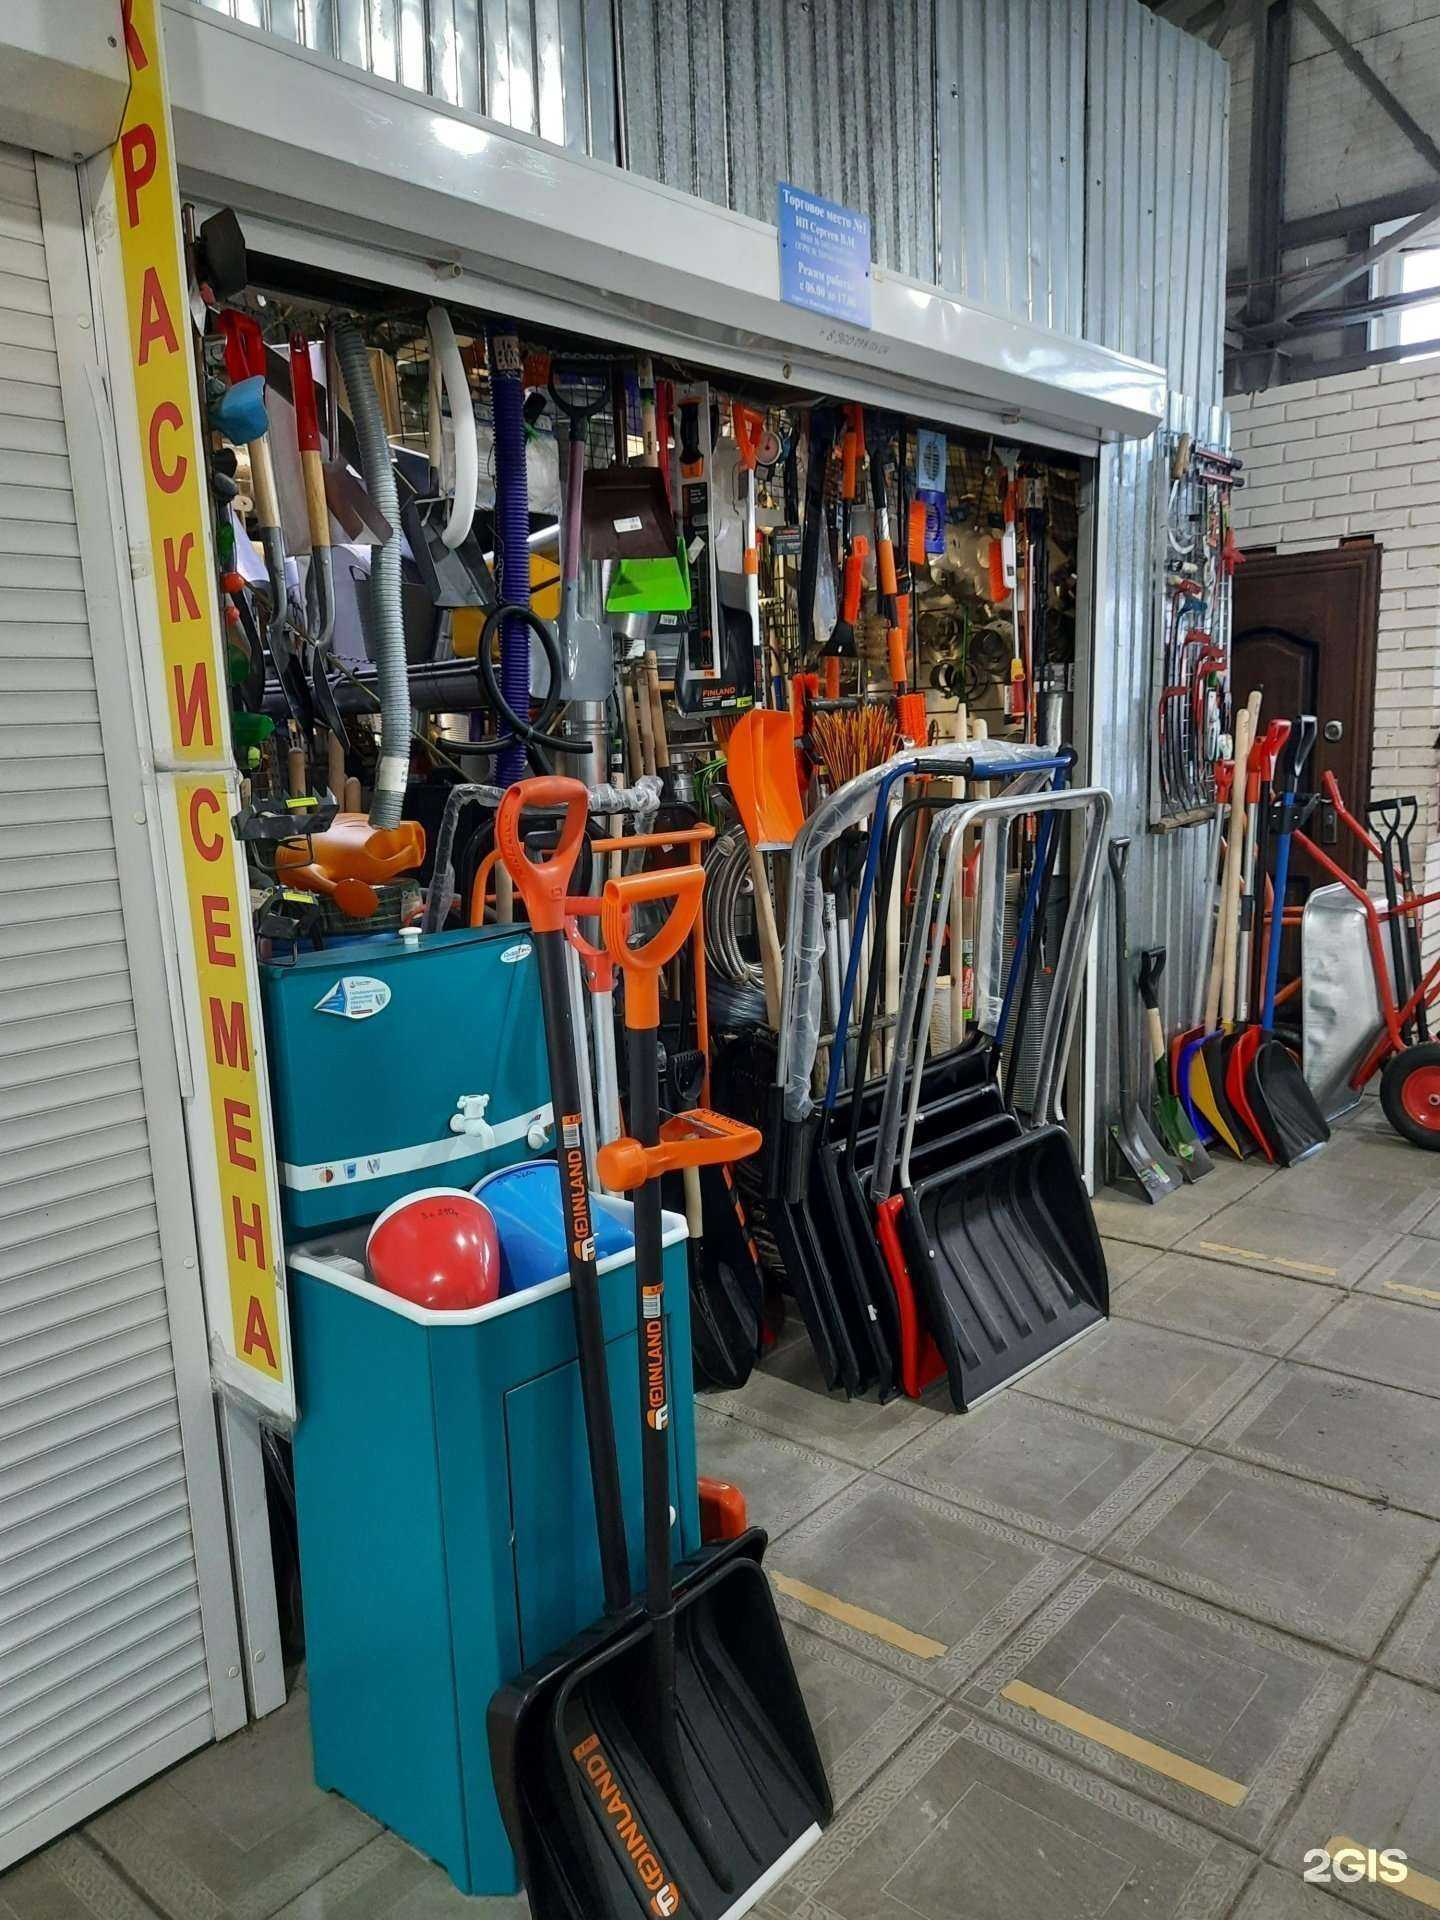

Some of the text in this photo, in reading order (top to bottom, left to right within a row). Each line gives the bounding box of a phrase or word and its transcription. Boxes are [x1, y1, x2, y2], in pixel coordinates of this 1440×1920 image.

[783, 188, 825, 217] Торговое
[826, 210, 853, 229] место
[795, 214, 809, 230] ИП
[798, 260, 825, 281] Режим
[703, 686, 736, 698] FINLAND
[189, 787, 279, 1370] СЕМЕНА
